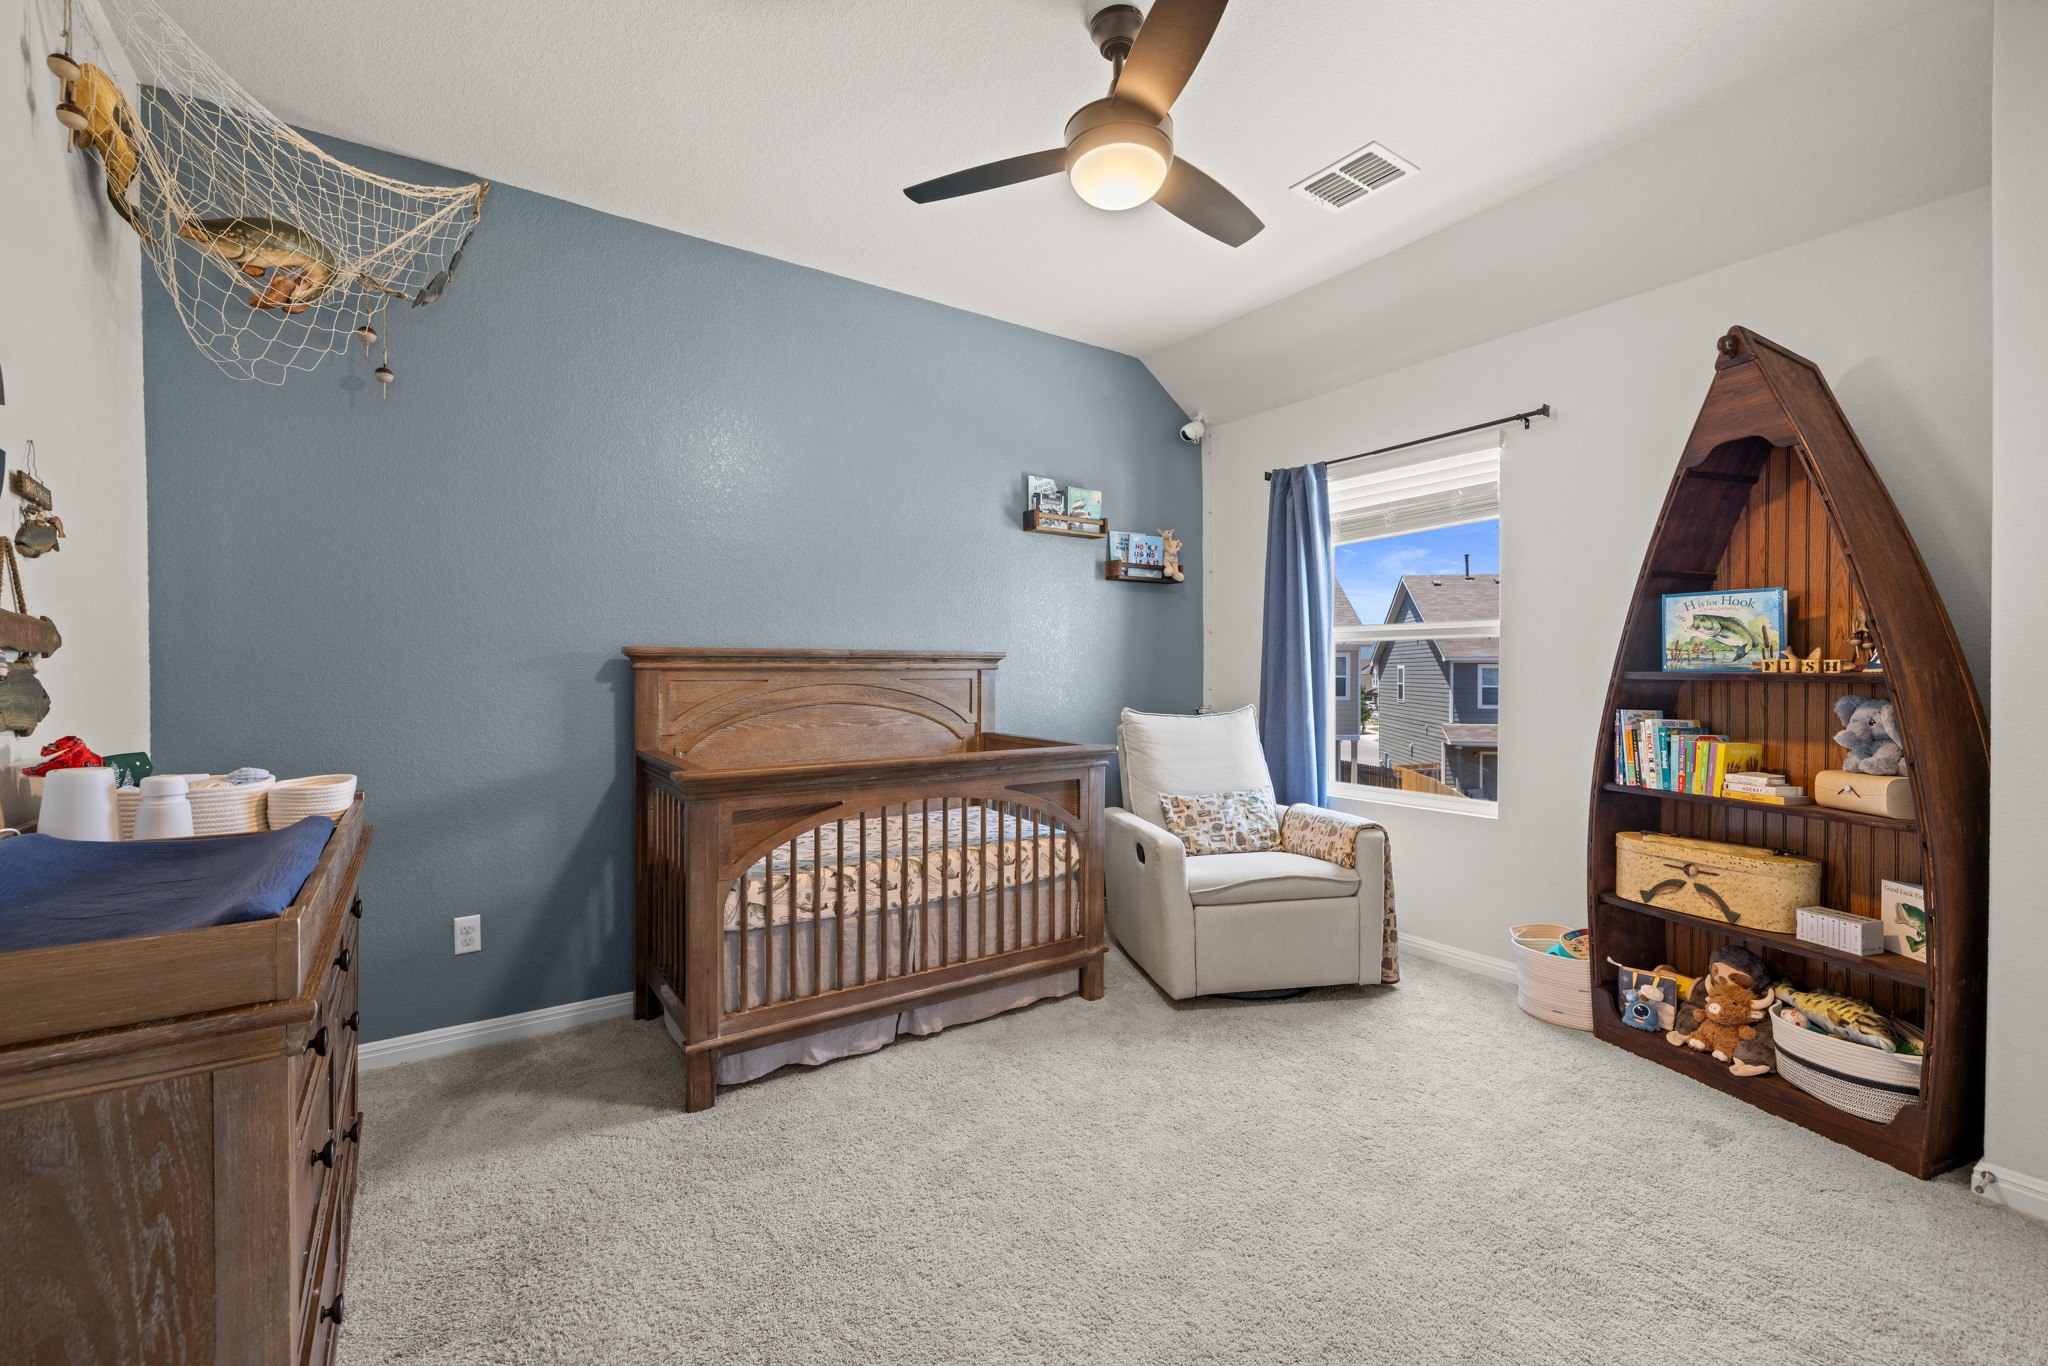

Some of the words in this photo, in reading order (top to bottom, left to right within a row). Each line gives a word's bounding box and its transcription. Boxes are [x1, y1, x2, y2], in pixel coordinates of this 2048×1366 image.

[1683, 600, 1696, 612] H
[1706, 599, 1718, 607] for
[1721, 595, 1756, 609] Hook
[1764, 661, 1839, 672] FISH
[1646, 732, 1654, 755] TRUCK?
[1741, 786, 1763, 794] HOCKEY
[1884, 884, 1899, 894] Good
[1900, 889, 1914, 898] Luck
